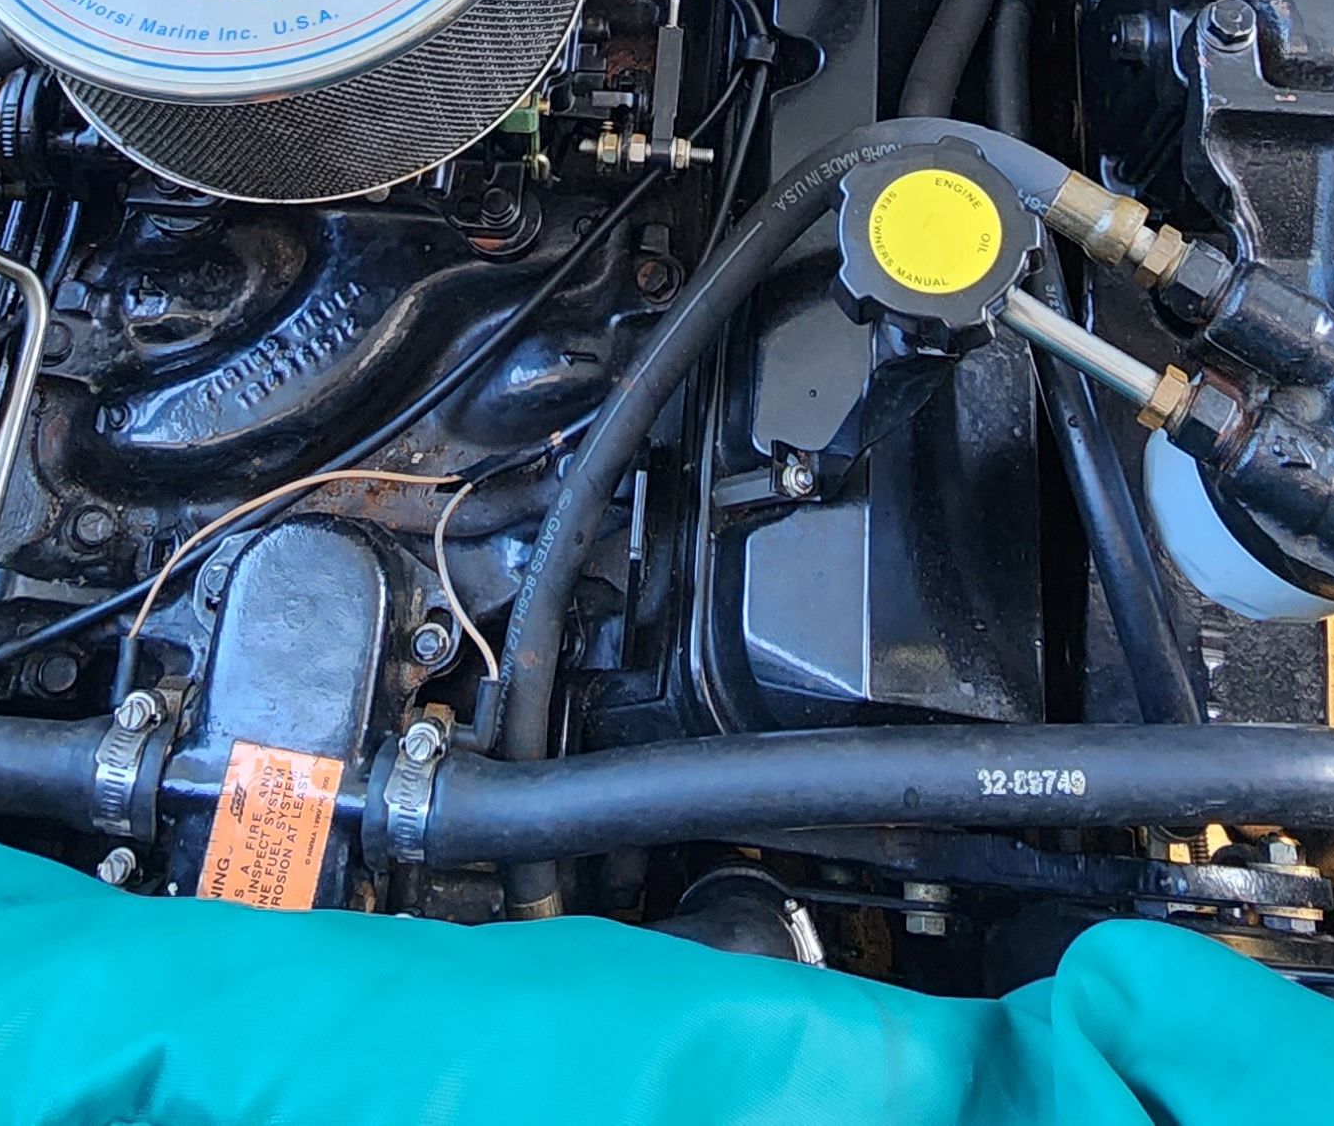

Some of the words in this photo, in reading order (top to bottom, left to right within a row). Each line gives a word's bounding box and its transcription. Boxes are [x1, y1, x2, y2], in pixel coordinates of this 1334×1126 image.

[138, 17, 210, 42] Marine
[218, 23, 258, 42] Inc.
[272, 10, 339, 36] U.S.A.
[804, 172, 823, 190] IN
[820, 149, 860, 180] MADE
[771, 180, 809, 213] U.S.A.
[879, 190, 898, 212] SEE
[935, 177, 983, 211] ENGINE
[873, 214, 895, 267] OWNERS
[977, 232, 992, 254] OIL
[895, 267, 950, 287] MANUAL
[530, 517, 561, 575] GATES
[514, 576, 537, 623] 8C6H
[507, 626, 522, 651] 1/2
[257, 764, 273, 798] AND
[290, 771, 310, 819] LEAST
[244, 811, 263, 851] FIRE
[247, 831, 271, 894] INSPECT
[262, 767, 285, 826] SYSTEM
[256, 884, 271, 908] INE
[264, 838, 282, 876] FUEL
[275, 769, 298, 831] SYSTEM
[284, 824, 298, 843] AT
[209, 856, 230, 899] NING
[239, 863, 251, 875] A
[269, 847, 293, 910] ROSION
[233, 887, 245, 898] S
